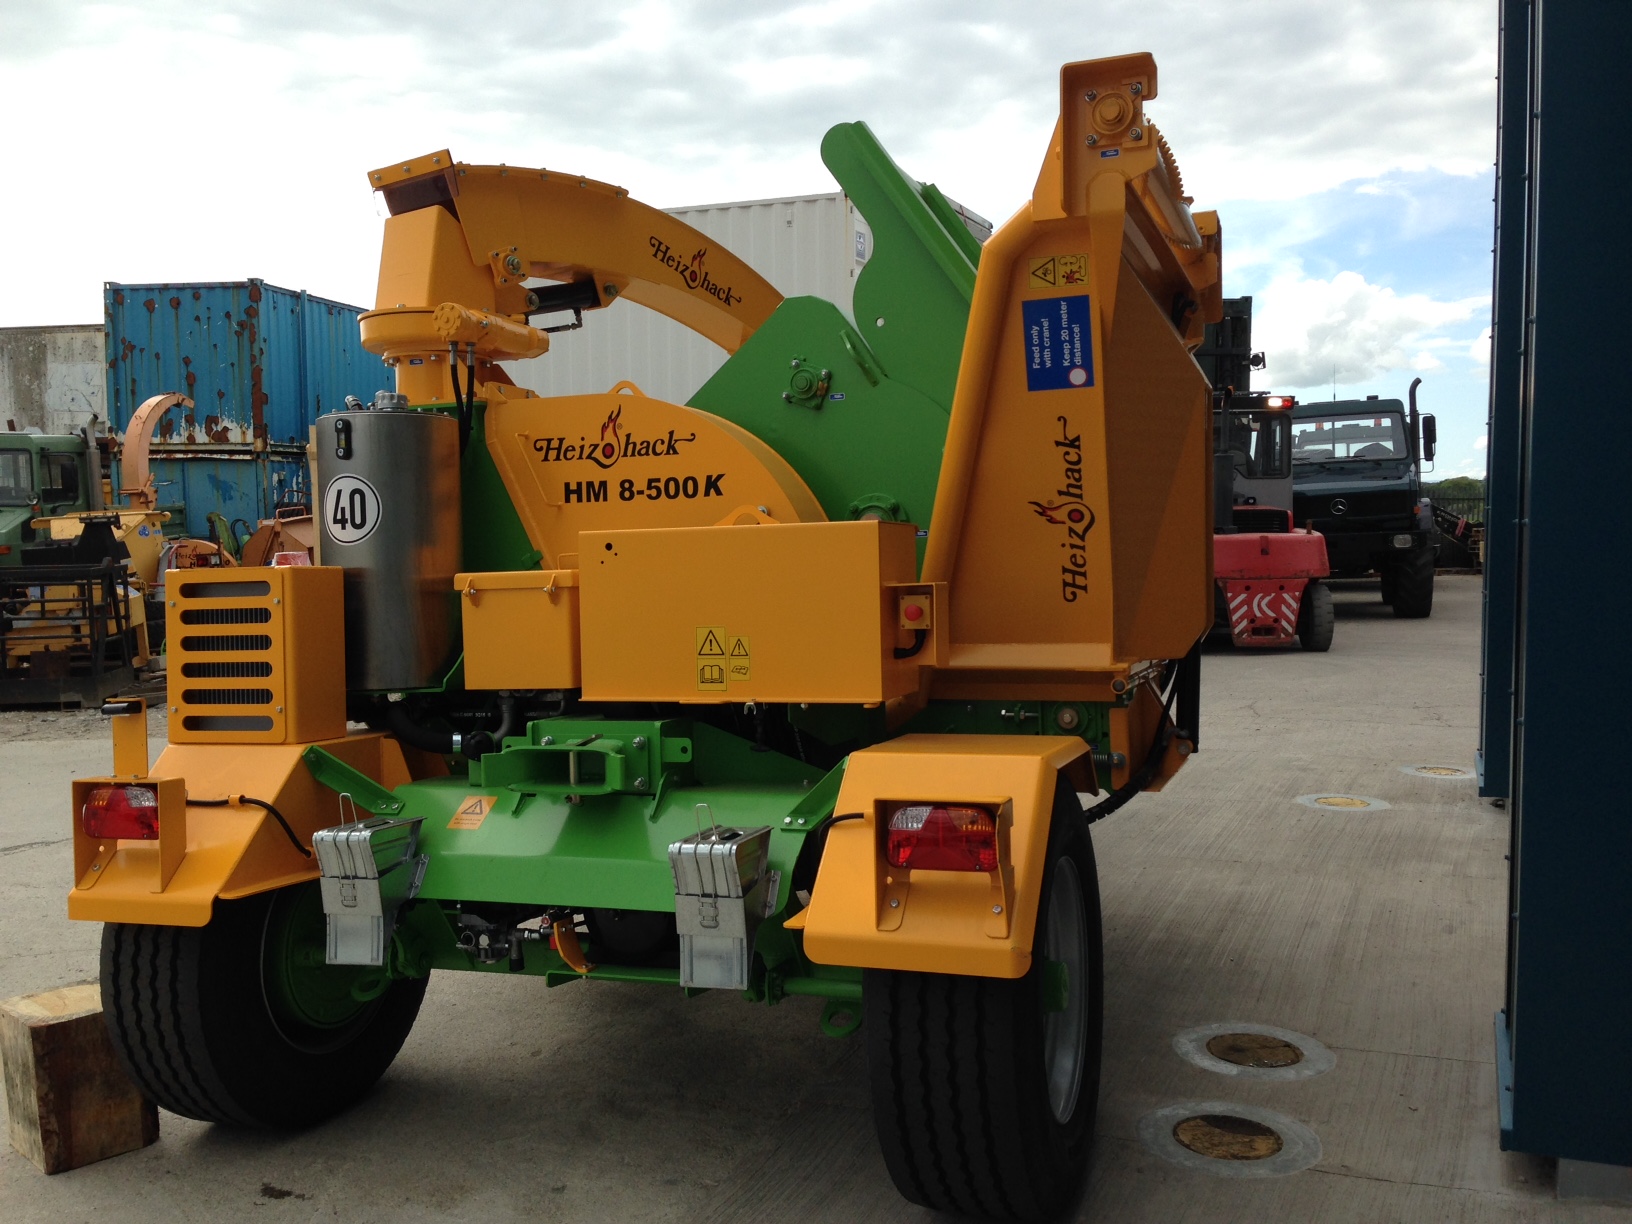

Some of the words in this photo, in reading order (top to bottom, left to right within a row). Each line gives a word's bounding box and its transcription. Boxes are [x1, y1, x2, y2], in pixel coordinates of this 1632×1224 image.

[1060, 301, 1068, 327] meter
[1031, 325, 1040, 344] only
[1041, 318, 1050, 346] crane!
[1061, 330, 1069, 340] 20
[1072, 324, 1081, 365] distance!
[1033, 346, 1041, 369] Feed
[1043, 348, 1052, 368] with
[1063, 342, 1072, 366] Keep
[563, 480, 608, 504] HM
[618, 476, 699, 502] 8-500
[703, 473, 726, 498] K
[332, 487, 367, 531] 40
